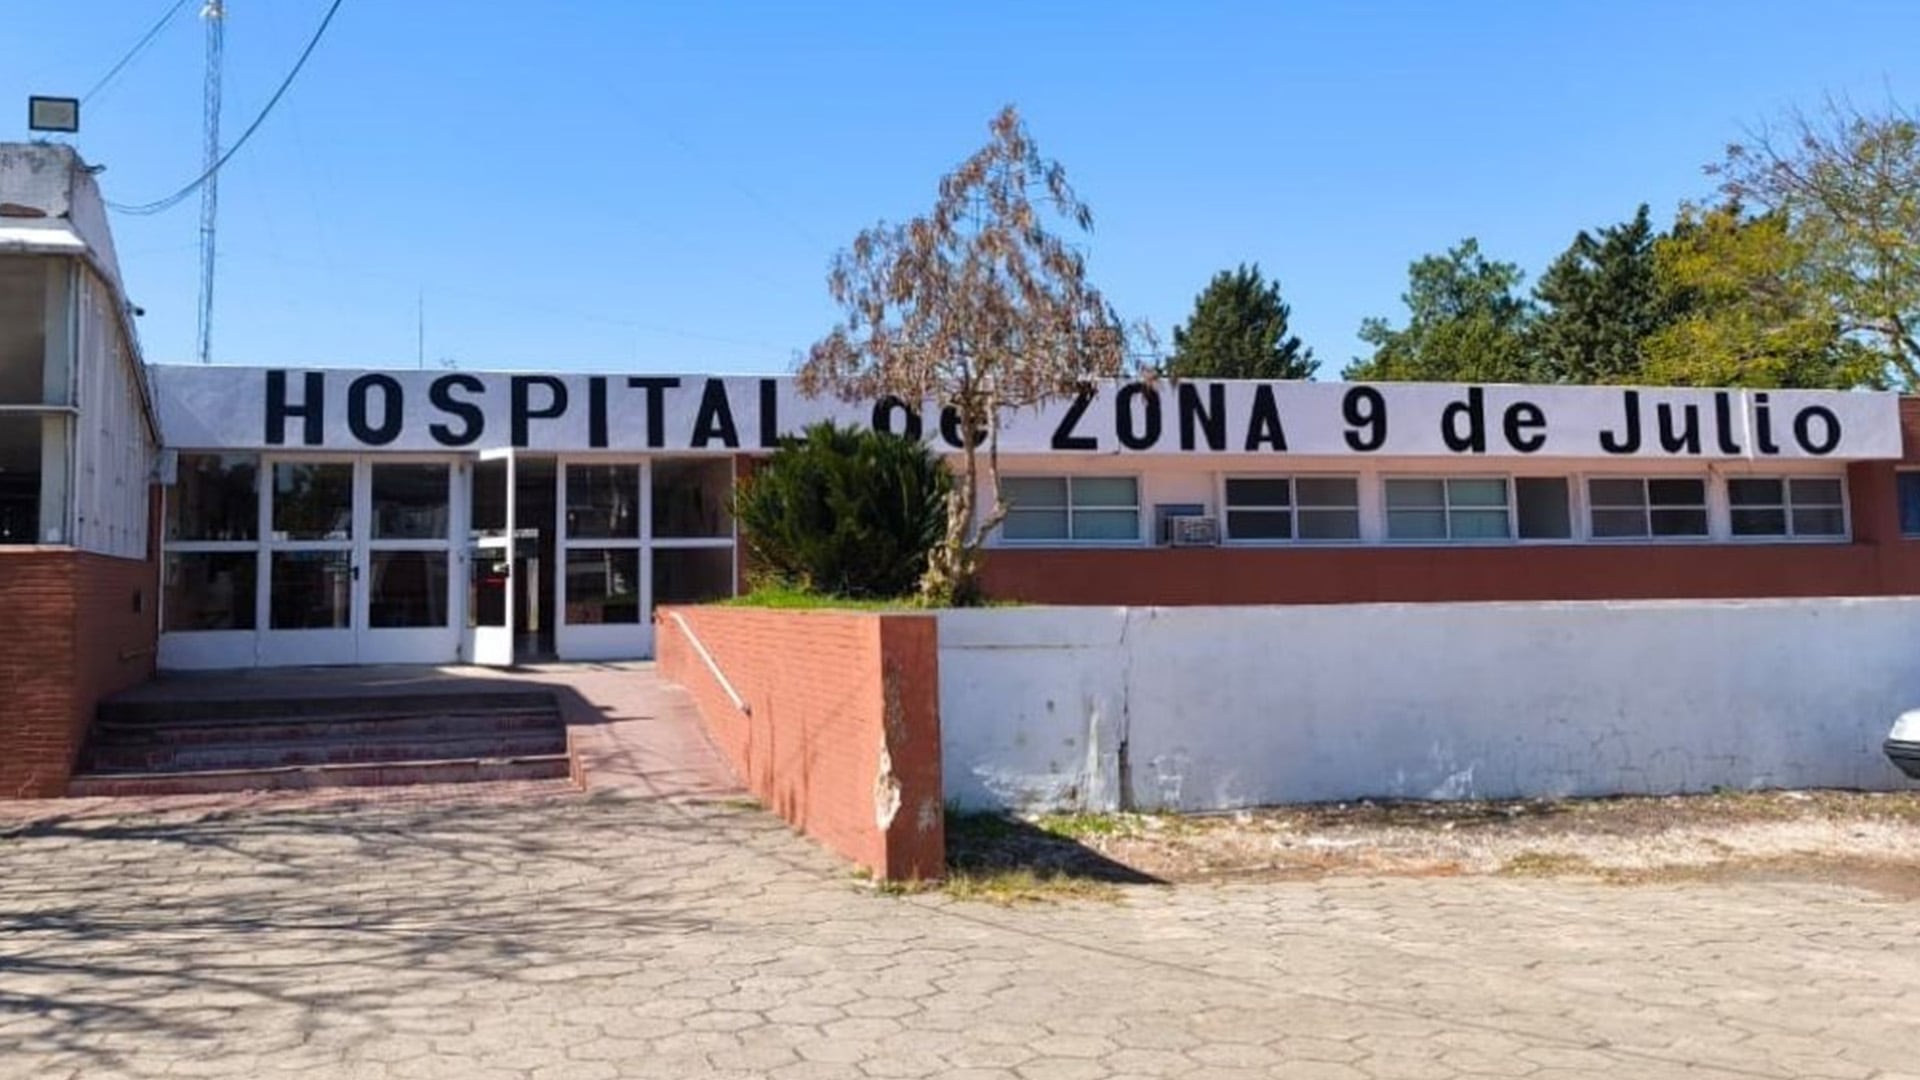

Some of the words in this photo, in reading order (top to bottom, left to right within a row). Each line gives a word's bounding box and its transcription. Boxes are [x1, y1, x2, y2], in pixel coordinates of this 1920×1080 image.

[265, 370, 809, 448] HOSPITAL
[1051, 380, 1288, 452] ZONA
[1342, 385, 1388, 452] 9
[1441, 387, 1547, 453] de
[1600, 390, 1841, 455] Julio
